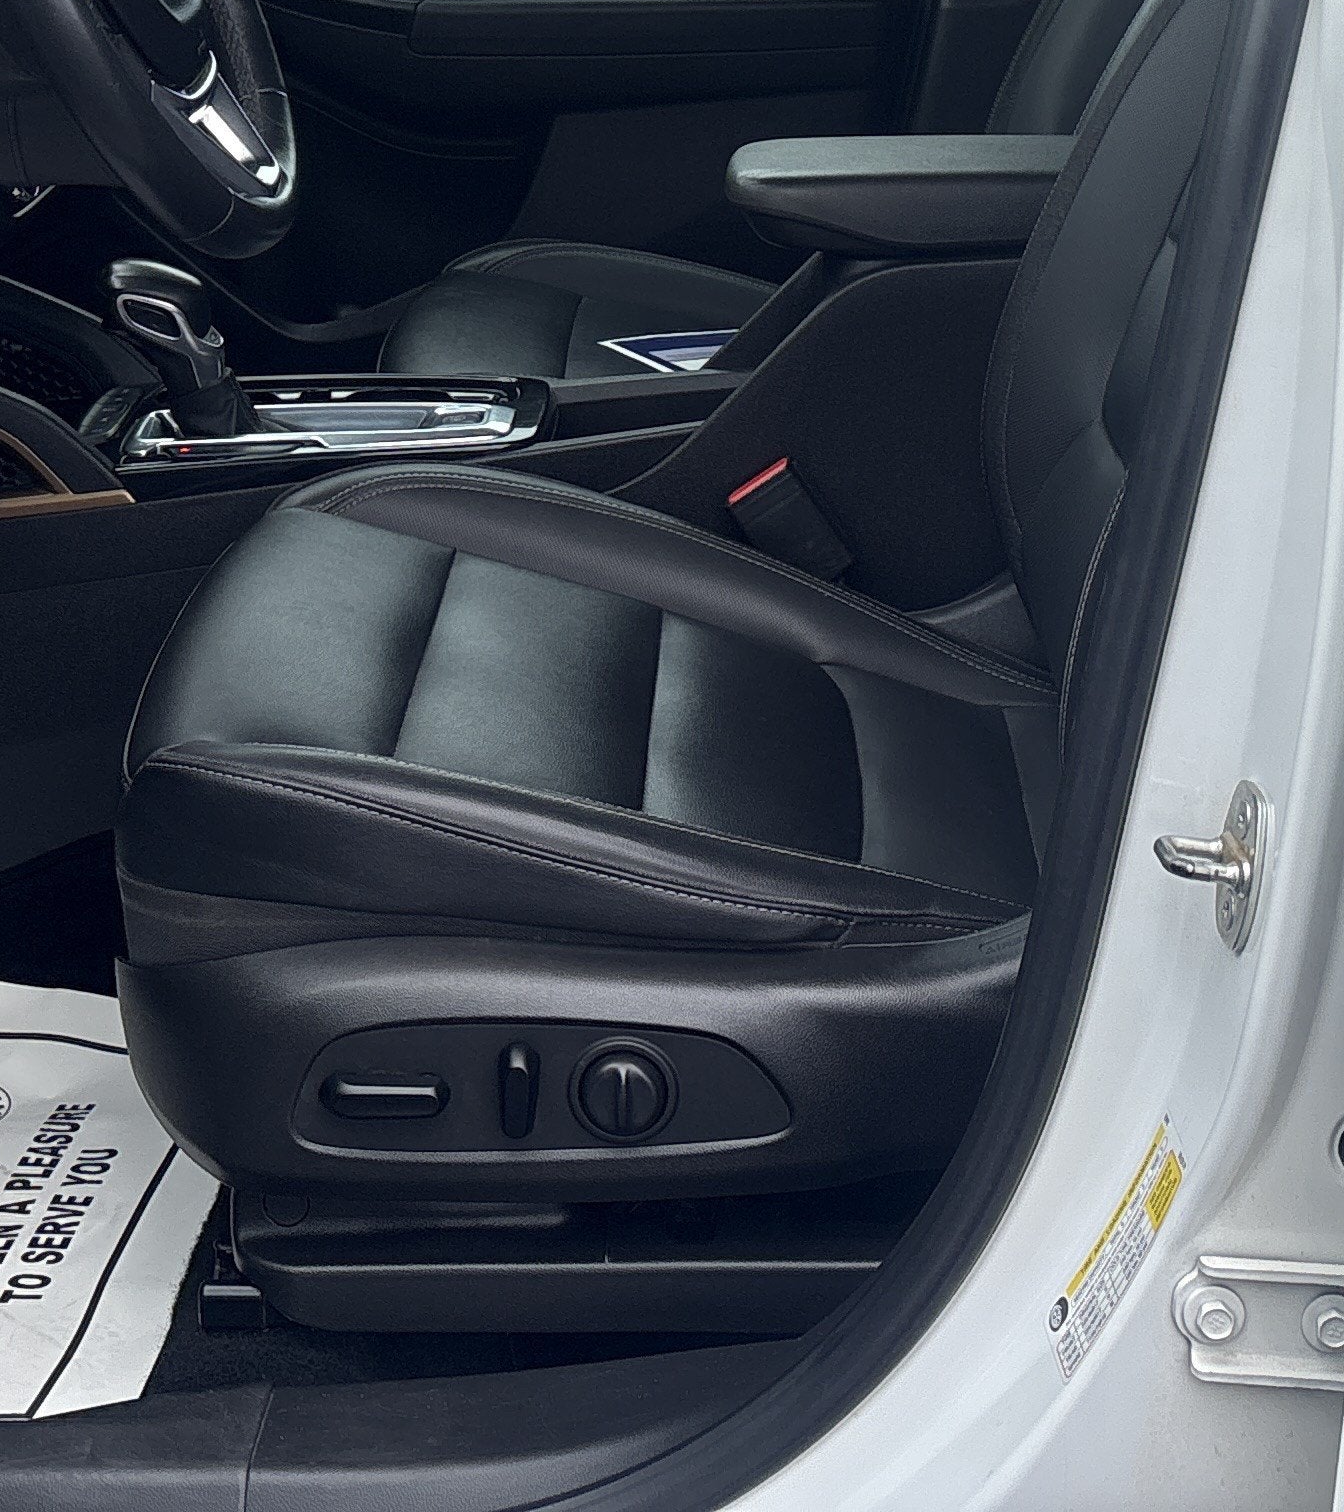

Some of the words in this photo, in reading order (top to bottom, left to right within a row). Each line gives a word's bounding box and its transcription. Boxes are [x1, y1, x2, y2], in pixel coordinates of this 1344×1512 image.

[4, 1103, 96, 1191] PLEASURE
[20, 1194, 94, 1264] SERVE
[60, 1148, 118, 1186] YOU
